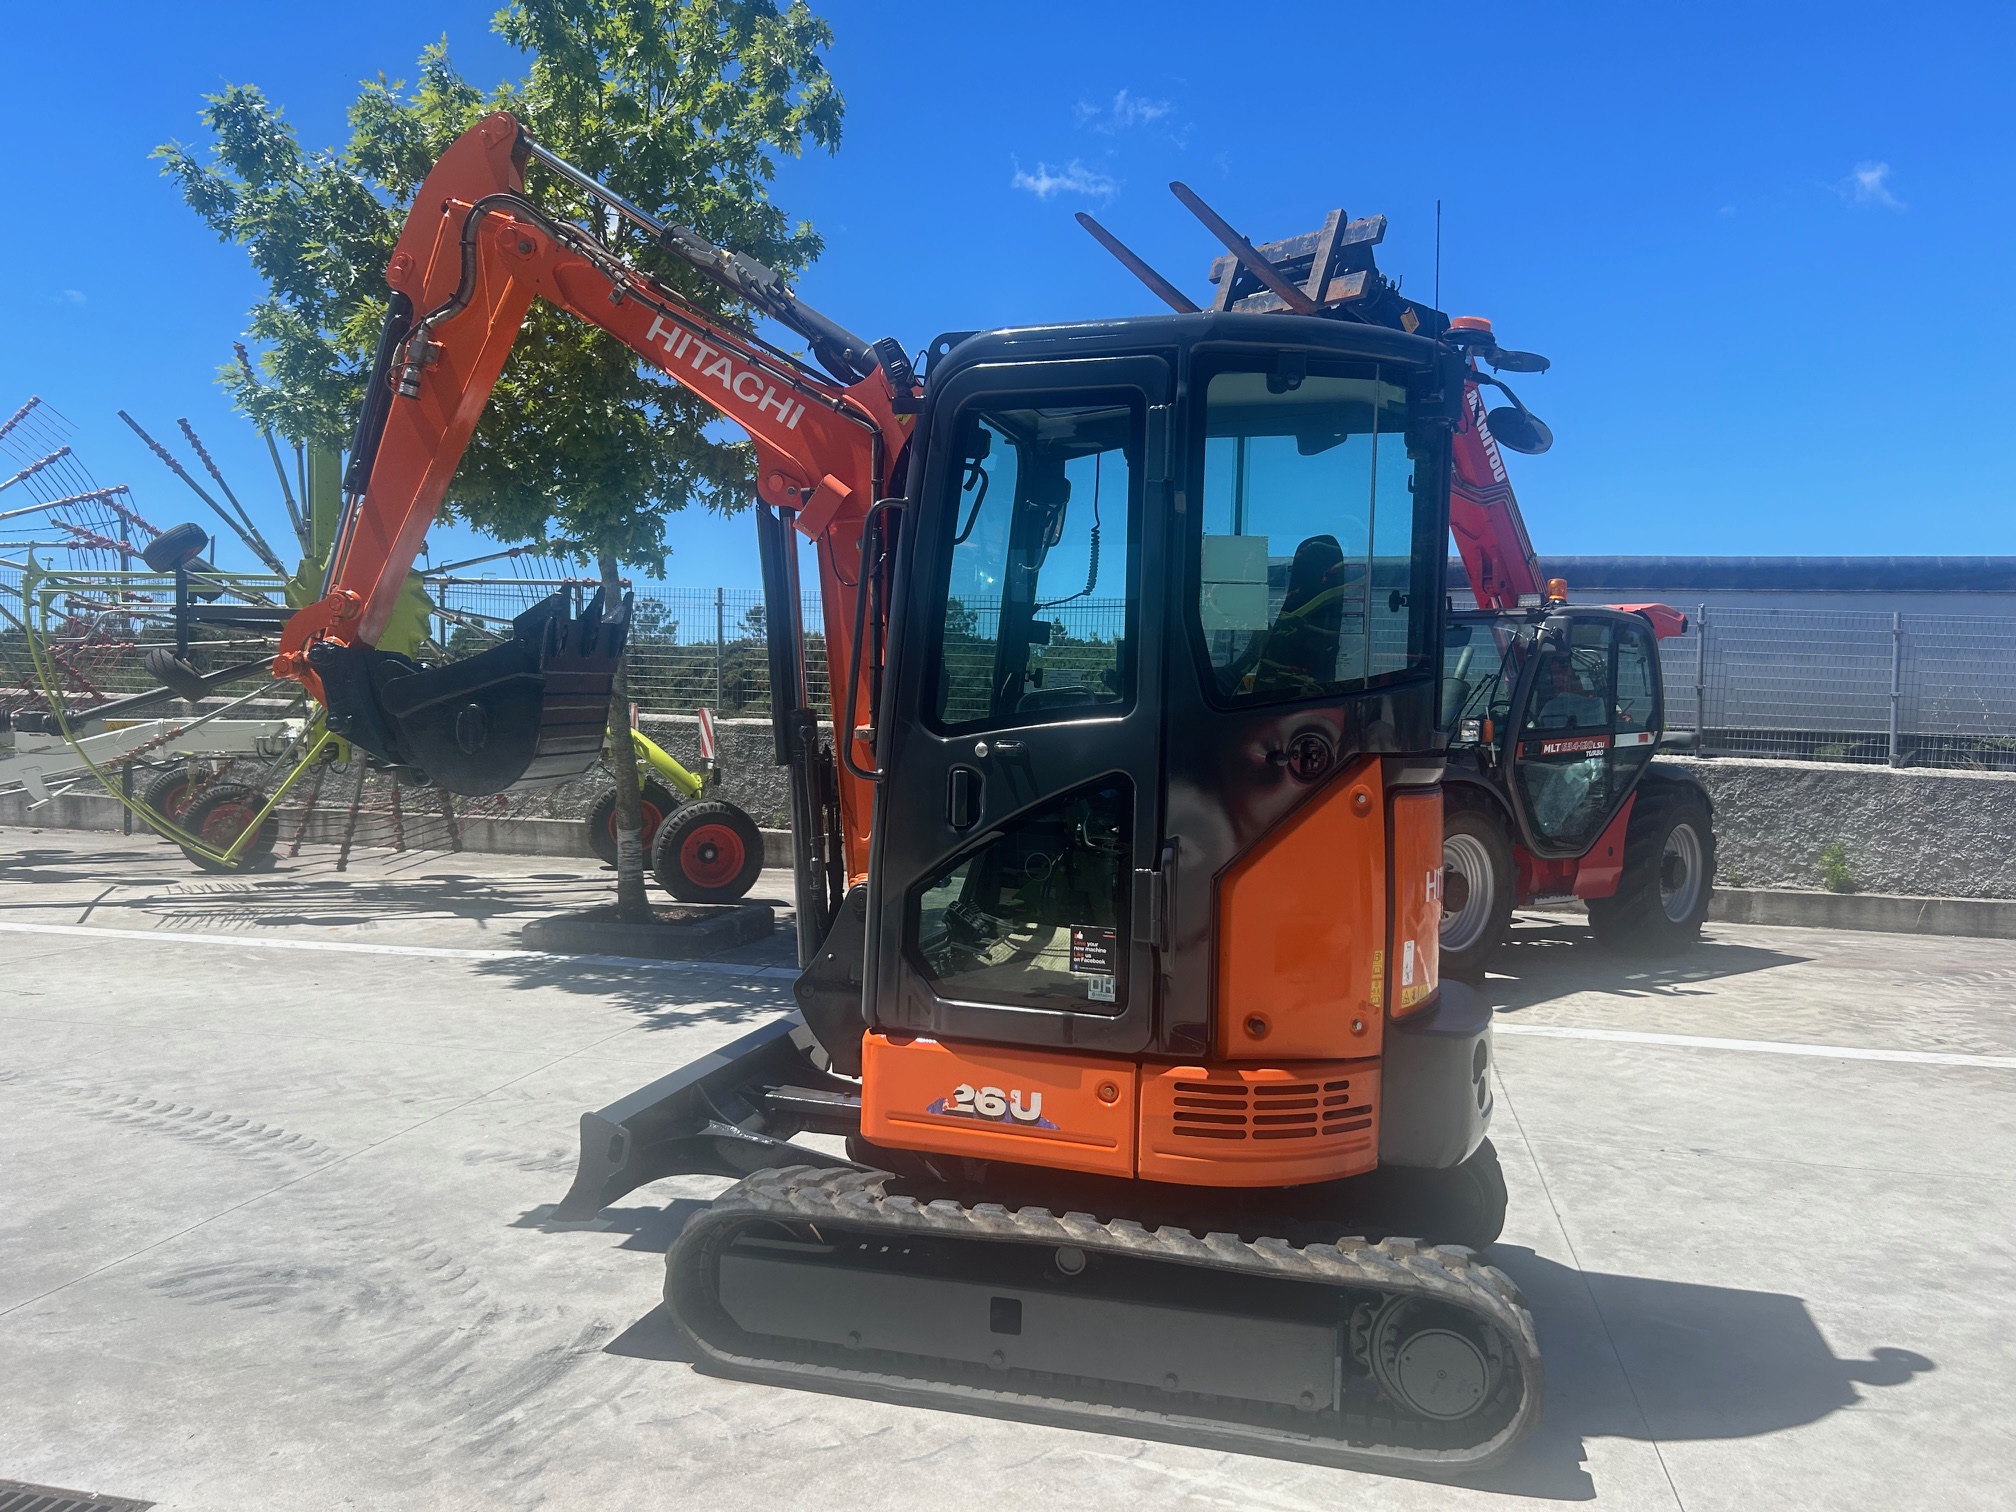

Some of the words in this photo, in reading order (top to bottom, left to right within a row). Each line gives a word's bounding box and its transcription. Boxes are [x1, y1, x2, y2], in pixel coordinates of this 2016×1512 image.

[646, 315, 806, 431] HITACHI
[1466, 389, 1507, 483] MANITOU
[1544, 743, 1562, 753] MLT
[1586, 749, 1604, 757] TURBO
[1081, 957, 1106, 965] Facebook
